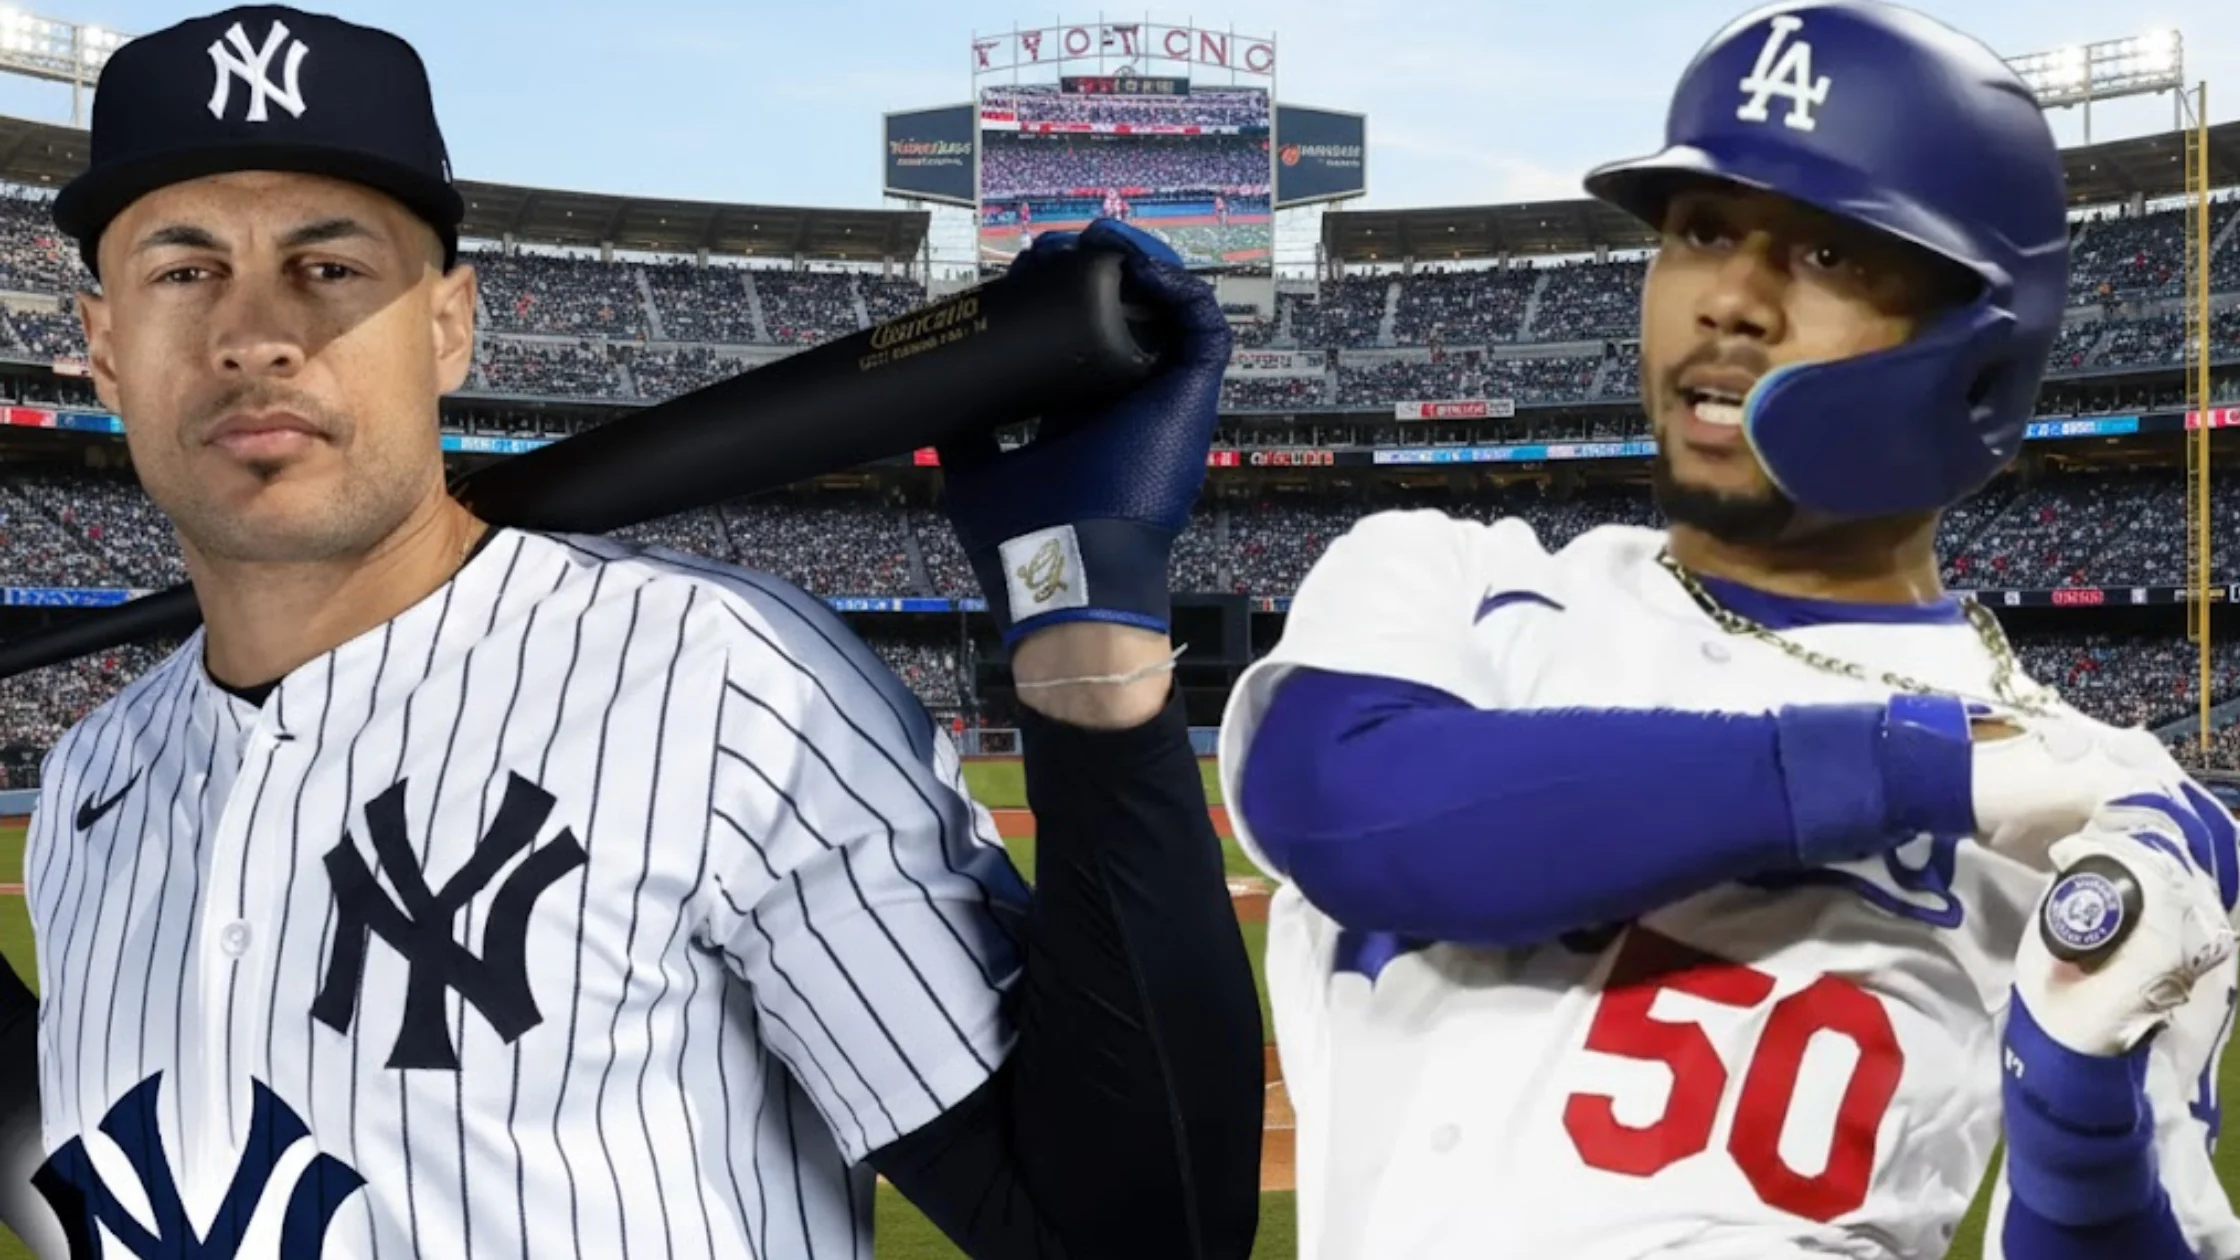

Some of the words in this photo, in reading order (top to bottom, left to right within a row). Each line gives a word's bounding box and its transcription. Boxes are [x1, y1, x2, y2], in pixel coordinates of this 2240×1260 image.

[206, 19, 309, 122] NY
[1737, 15, 1831, 132] LA
[309, 769, 590, 1070] NY
[1562, 922, 1905, 1224] 50
